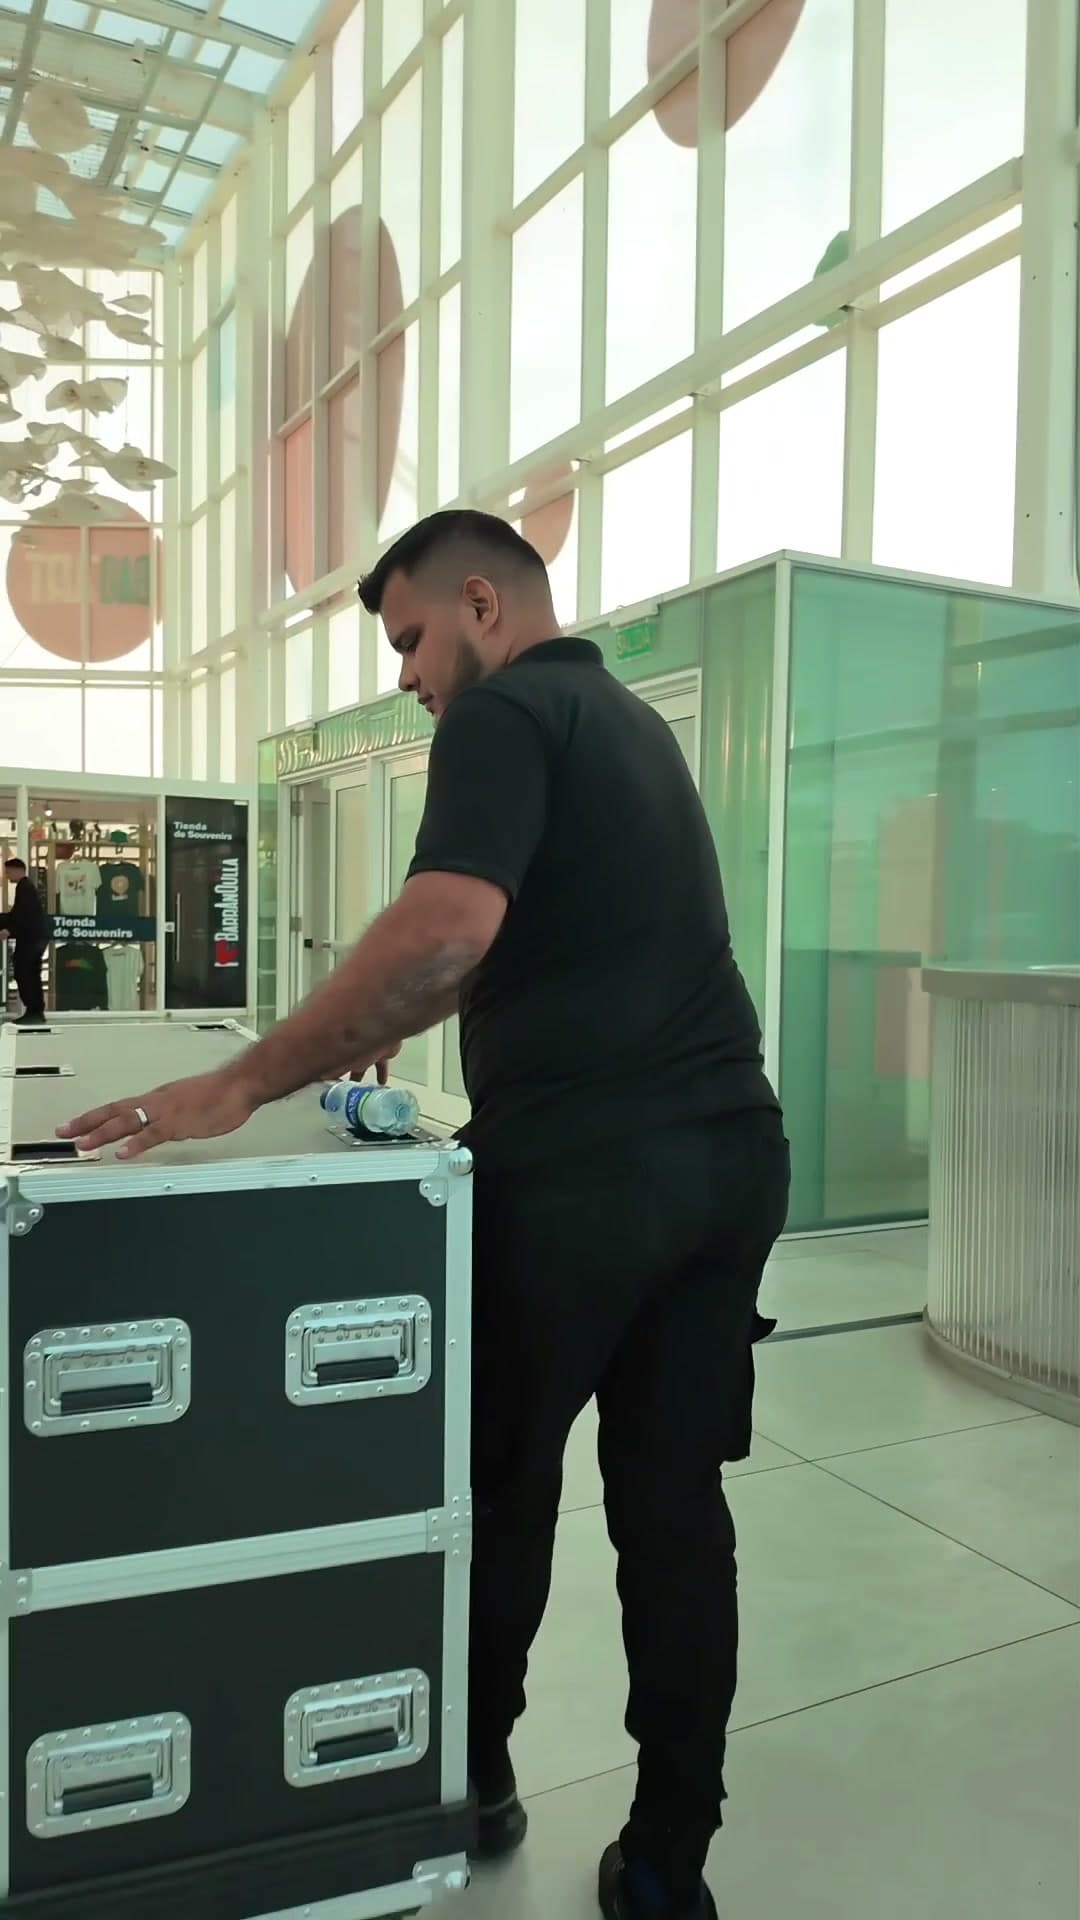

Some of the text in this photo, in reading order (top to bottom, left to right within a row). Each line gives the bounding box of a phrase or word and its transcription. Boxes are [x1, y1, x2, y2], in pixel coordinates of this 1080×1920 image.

[173, 821, 207, 831] Tienda
[173, 830, 232, 841] de Souvenirs
[53, 916, 96, 927] Tienda
[53, 927, 133, 938] de Souvenirs
